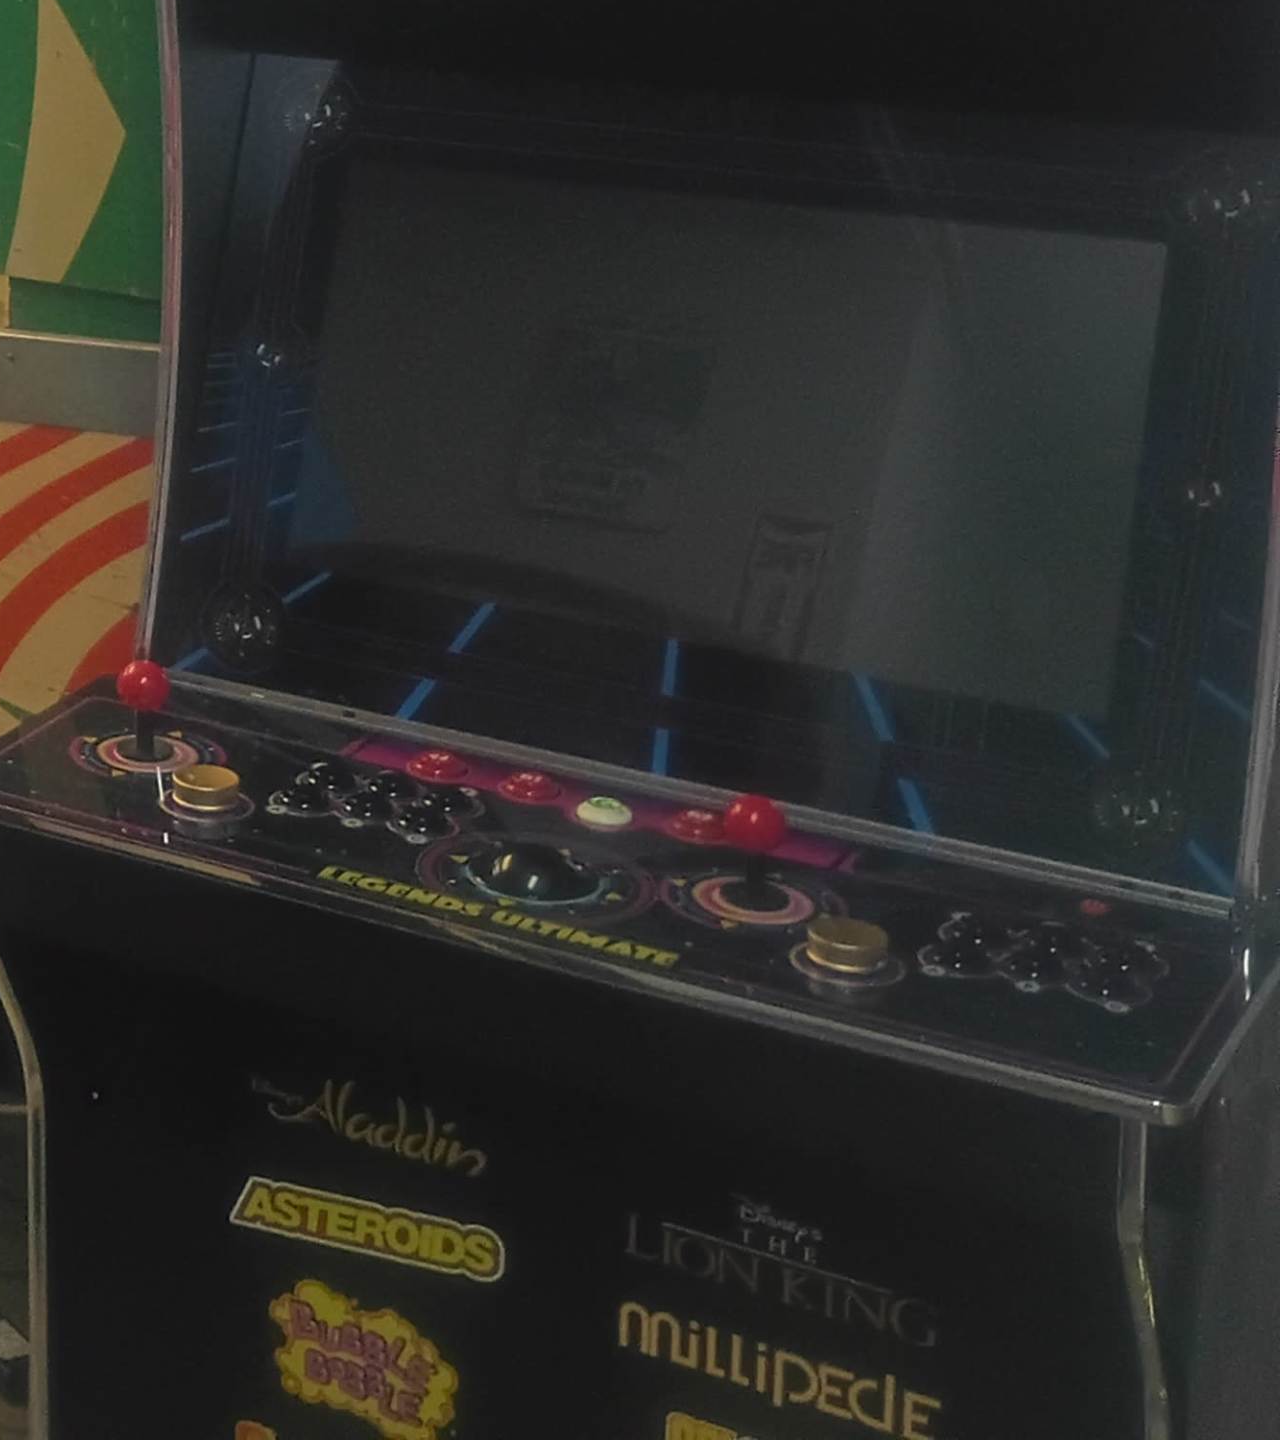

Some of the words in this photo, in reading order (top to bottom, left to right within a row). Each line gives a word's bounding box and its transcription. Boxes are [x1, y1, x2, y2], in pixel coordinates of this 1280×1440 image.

[316, 864, 486, 918] LEGENDS
[490, 909, 681, 968] ULTIMATE
[268, 1078, 488, 1178] Aladdin
[242, 1186, 496, 1272] ASTEROIDS
[741, 1228, 818, 1265] THE
[623, 1213, 761, 1295] LION
[780, 1265, 939, 1348] KING
[288, 1298, 439, 1396] BUBBLE
[304, 1347, 424, 1427] BOBBLE
